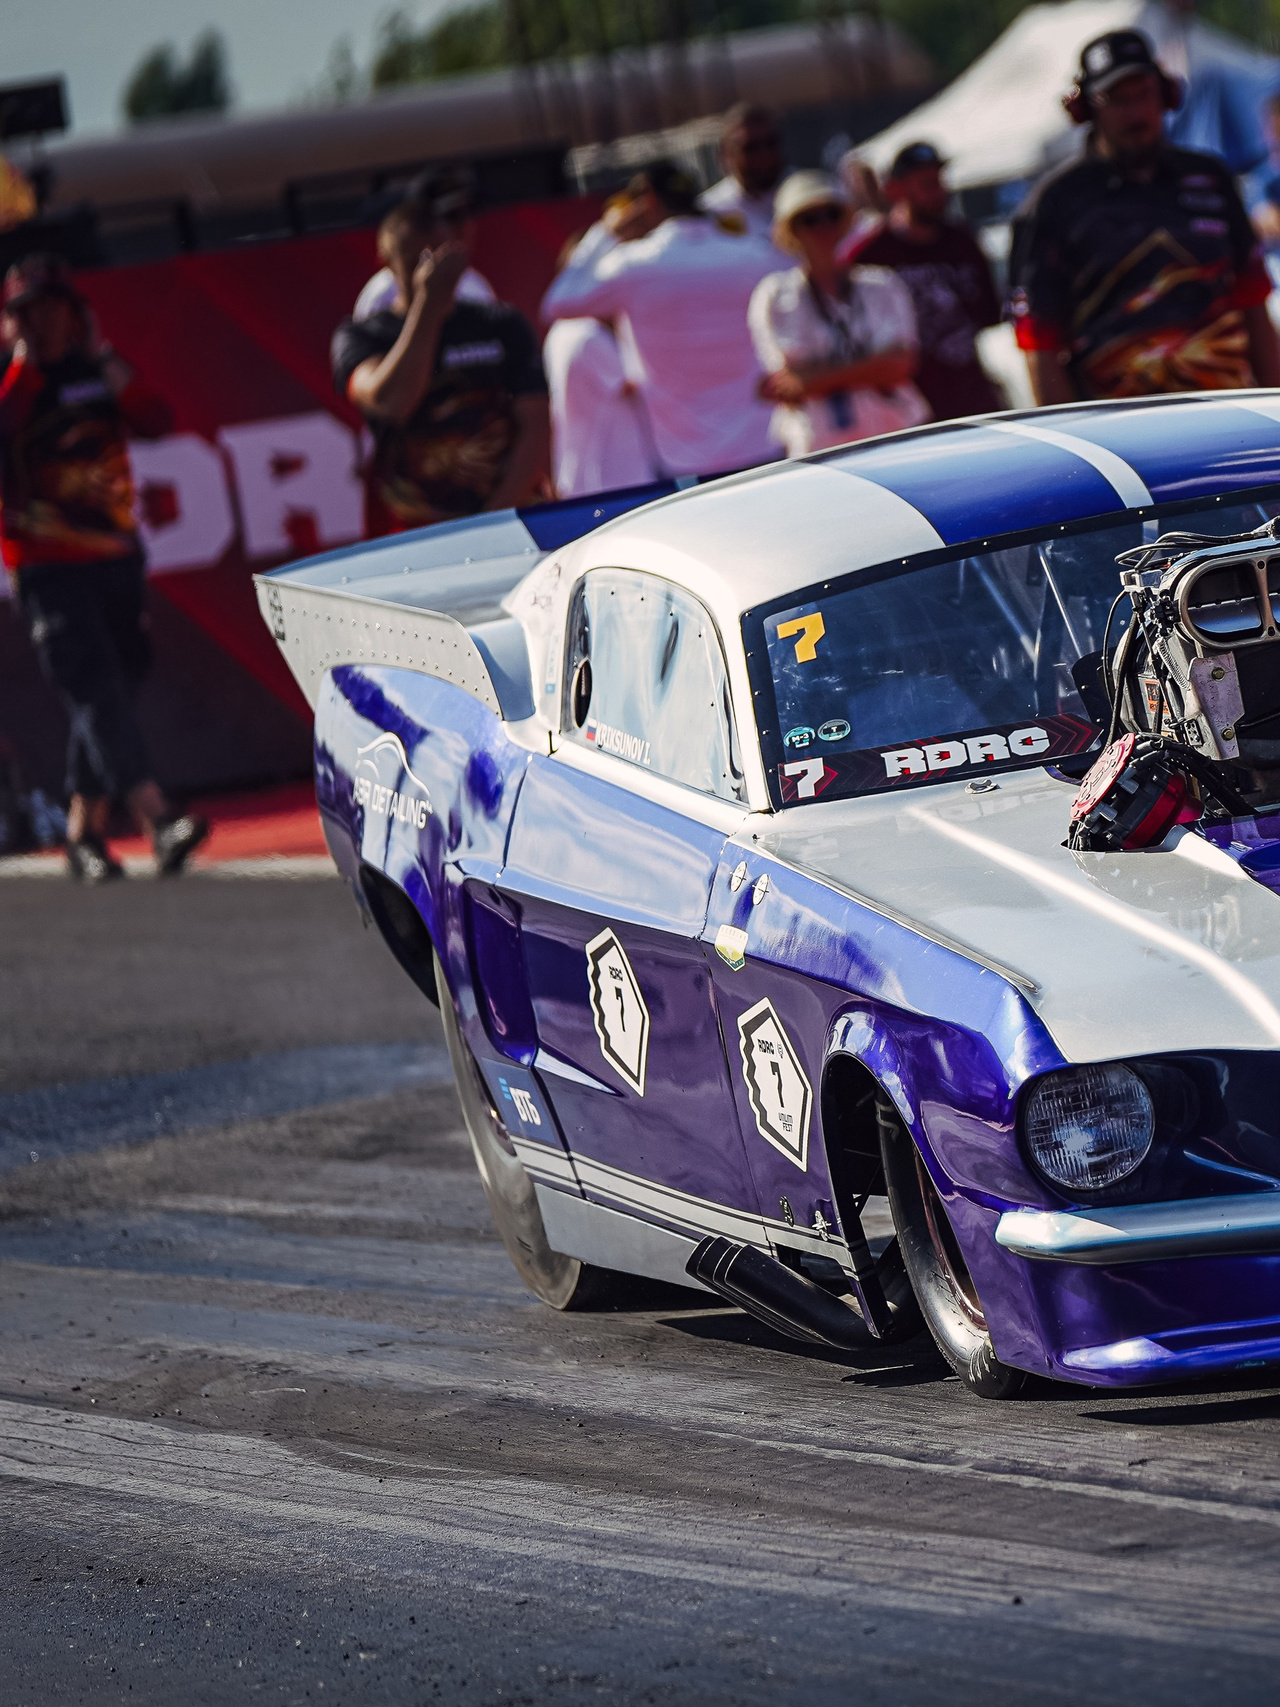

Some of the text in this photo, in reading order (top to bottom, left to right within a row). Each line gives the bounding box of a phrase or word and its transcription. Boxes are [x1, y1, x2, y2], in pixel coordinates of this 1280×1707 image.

[776, 612, 826, 663] 7
[880, 726, 1050, 778] RDRC
[783, 757, 825, 798] 7
[614, 985, 626, 1032] 7
[769, 1060, 785, 1108] 7
